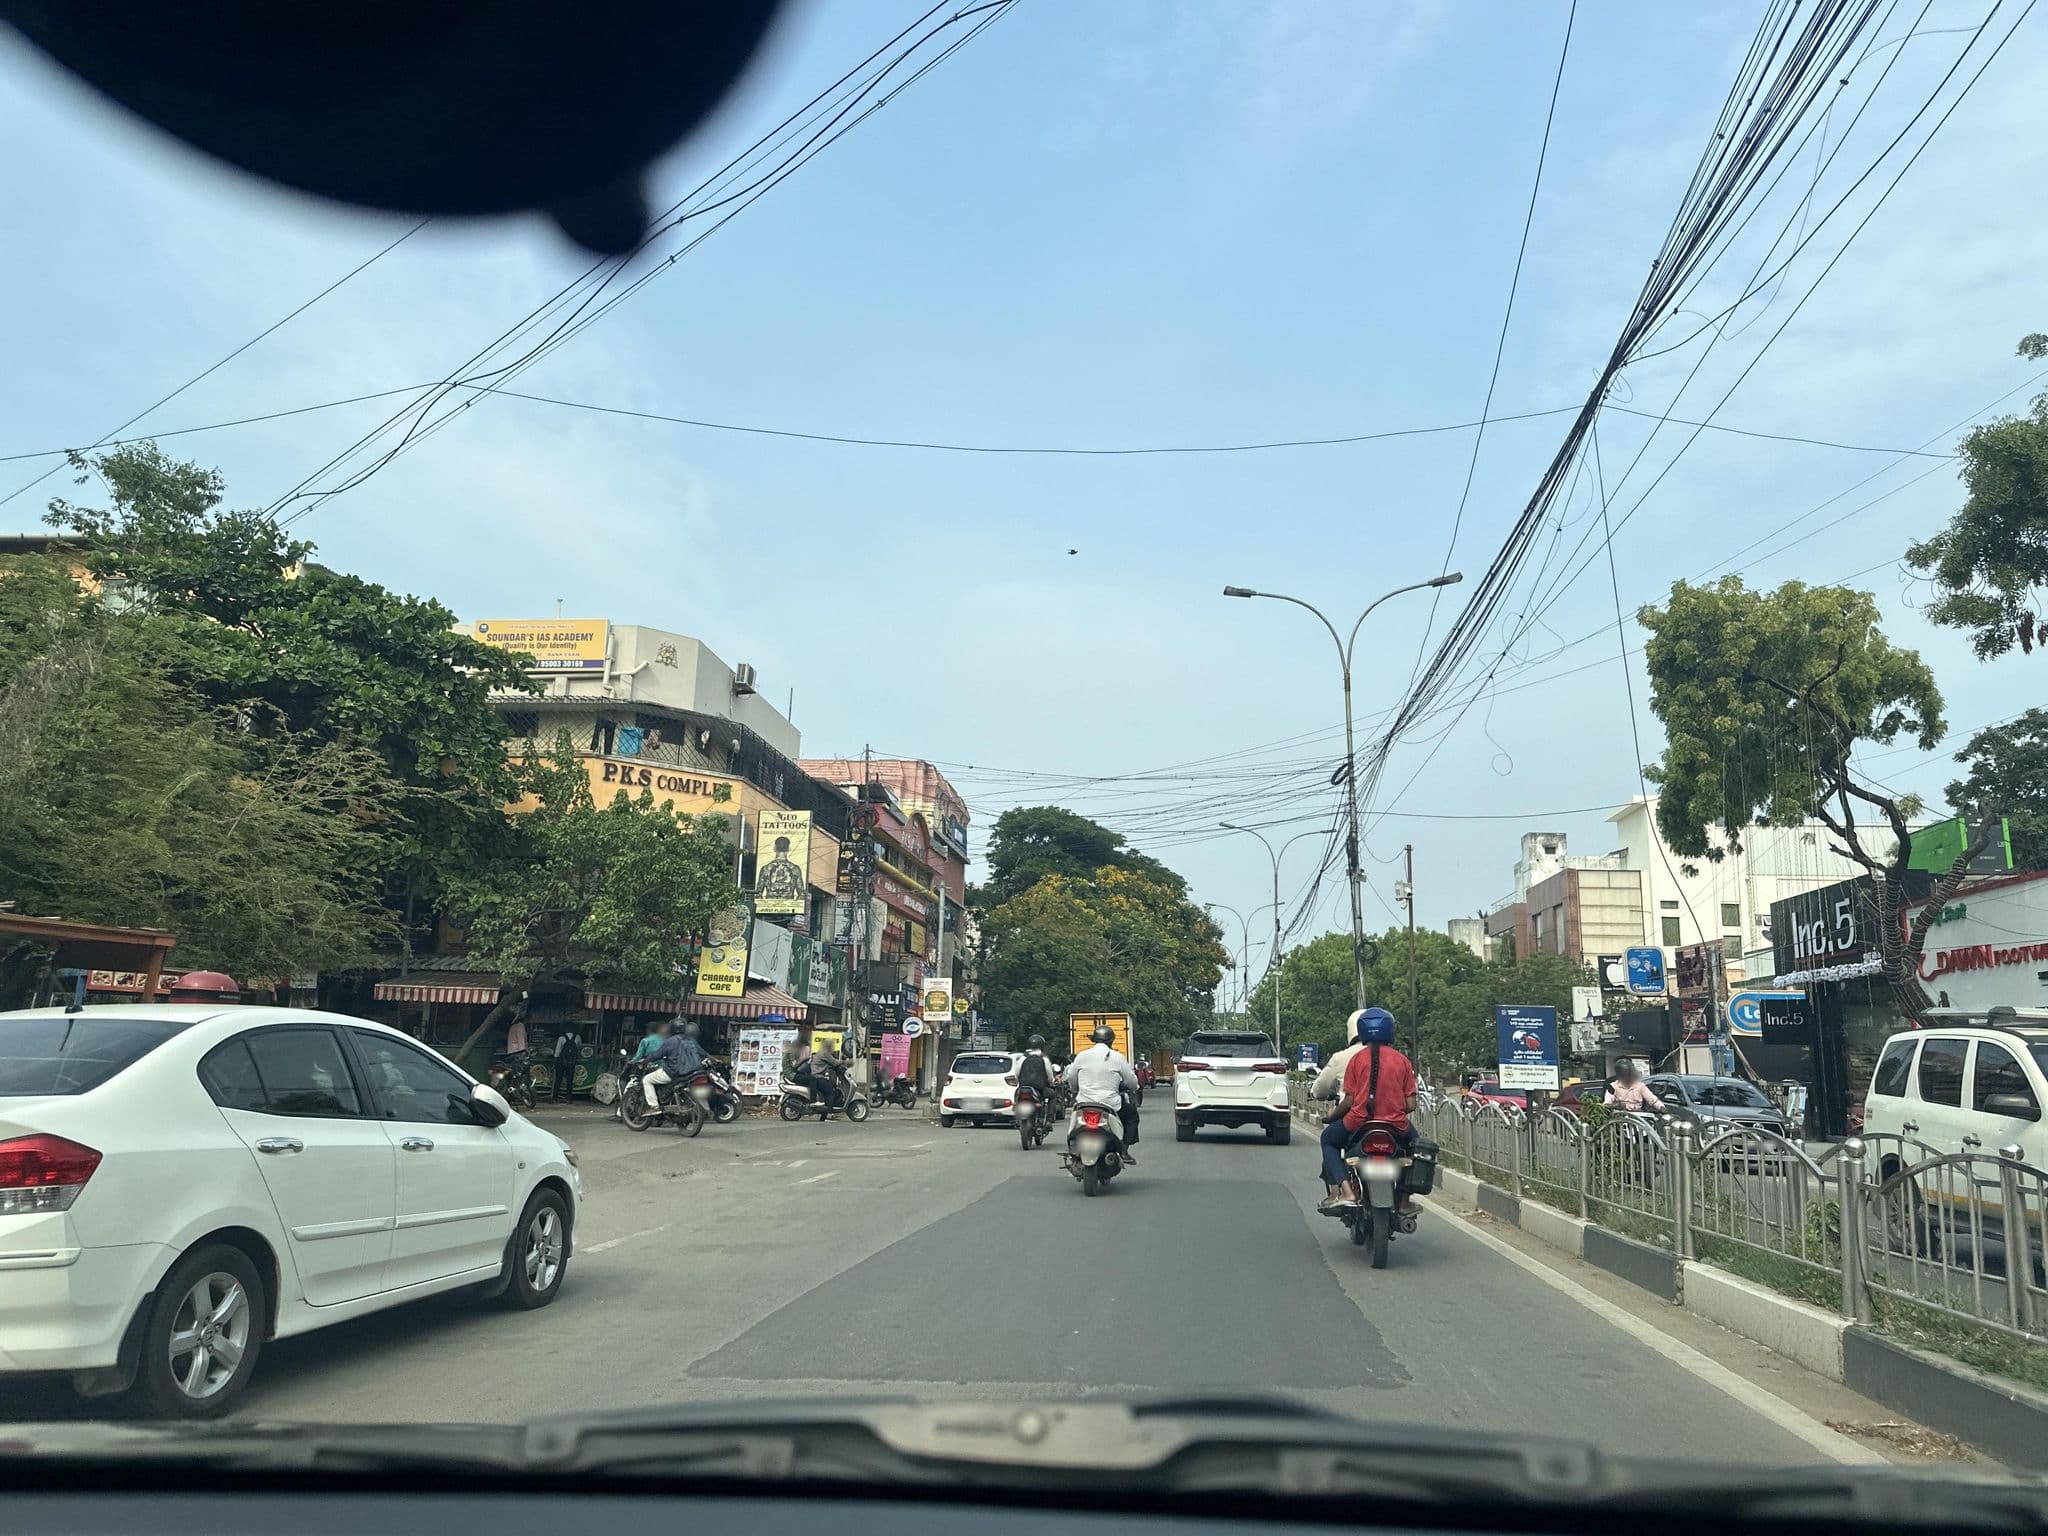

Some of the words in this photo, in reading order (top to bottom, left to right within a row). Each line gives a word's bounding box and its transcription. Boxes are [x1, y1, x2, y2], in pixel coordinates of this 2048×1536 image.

[487, 633, 534, 642] SOUNDAR'S
[537, 633, 551, 641] IAS
[553, 632, 594, 641] ACADEMY
[657, 774, 723, 797] COMPLE
[762, 821, 808, 829] TATTOOS
[1936, 944, 1994, 973] DAWN
[709, 983, 732, 991] CAFE
[1767, 1012, 1804, 1026] Inc.5
